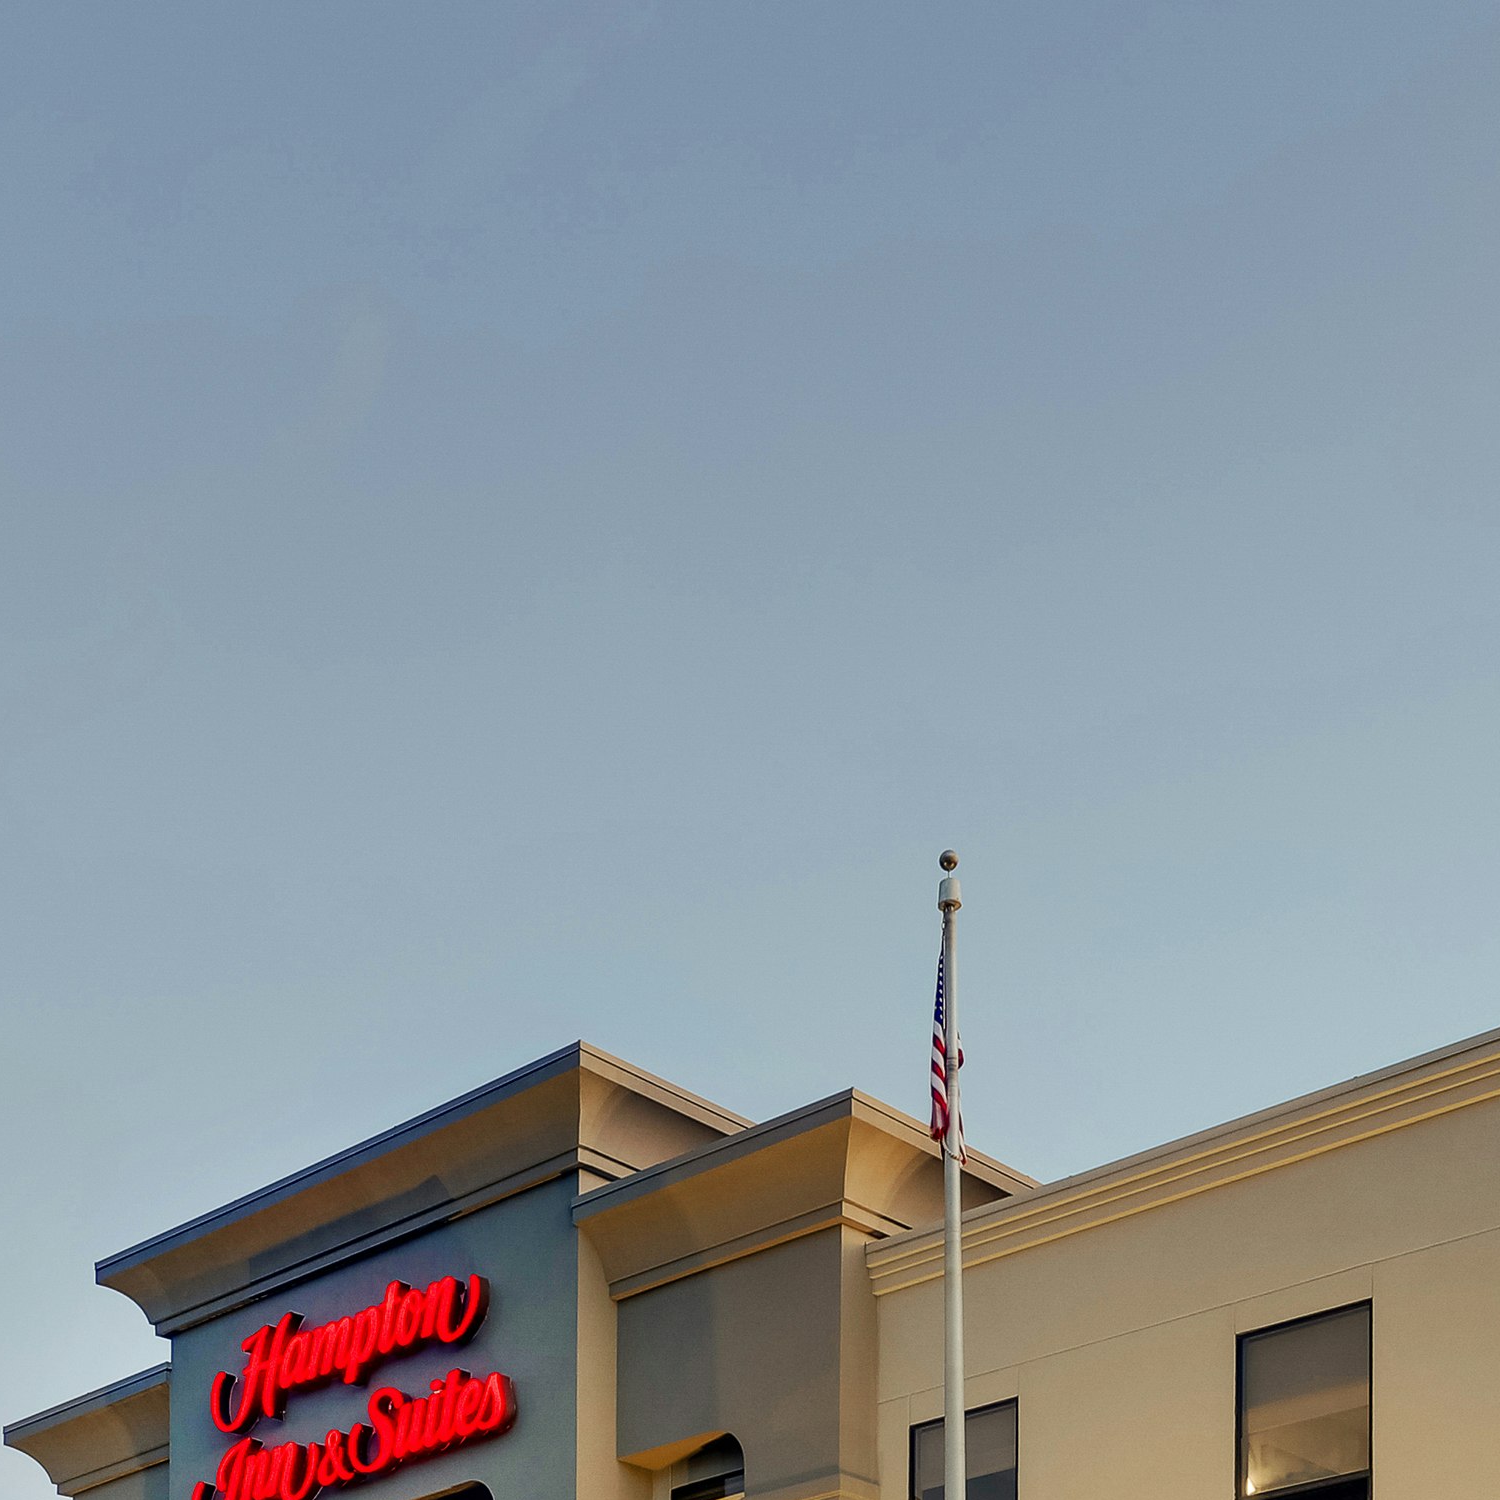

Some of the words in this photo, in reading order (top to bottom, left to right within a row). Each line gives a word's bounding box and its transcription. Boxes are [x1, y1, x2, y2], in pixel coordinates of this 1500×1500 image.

[210, 1273, 490, 1434] Hampton
[317, 1429, 356, 1487] &
[350, 1368, 514, 1474] Suites
